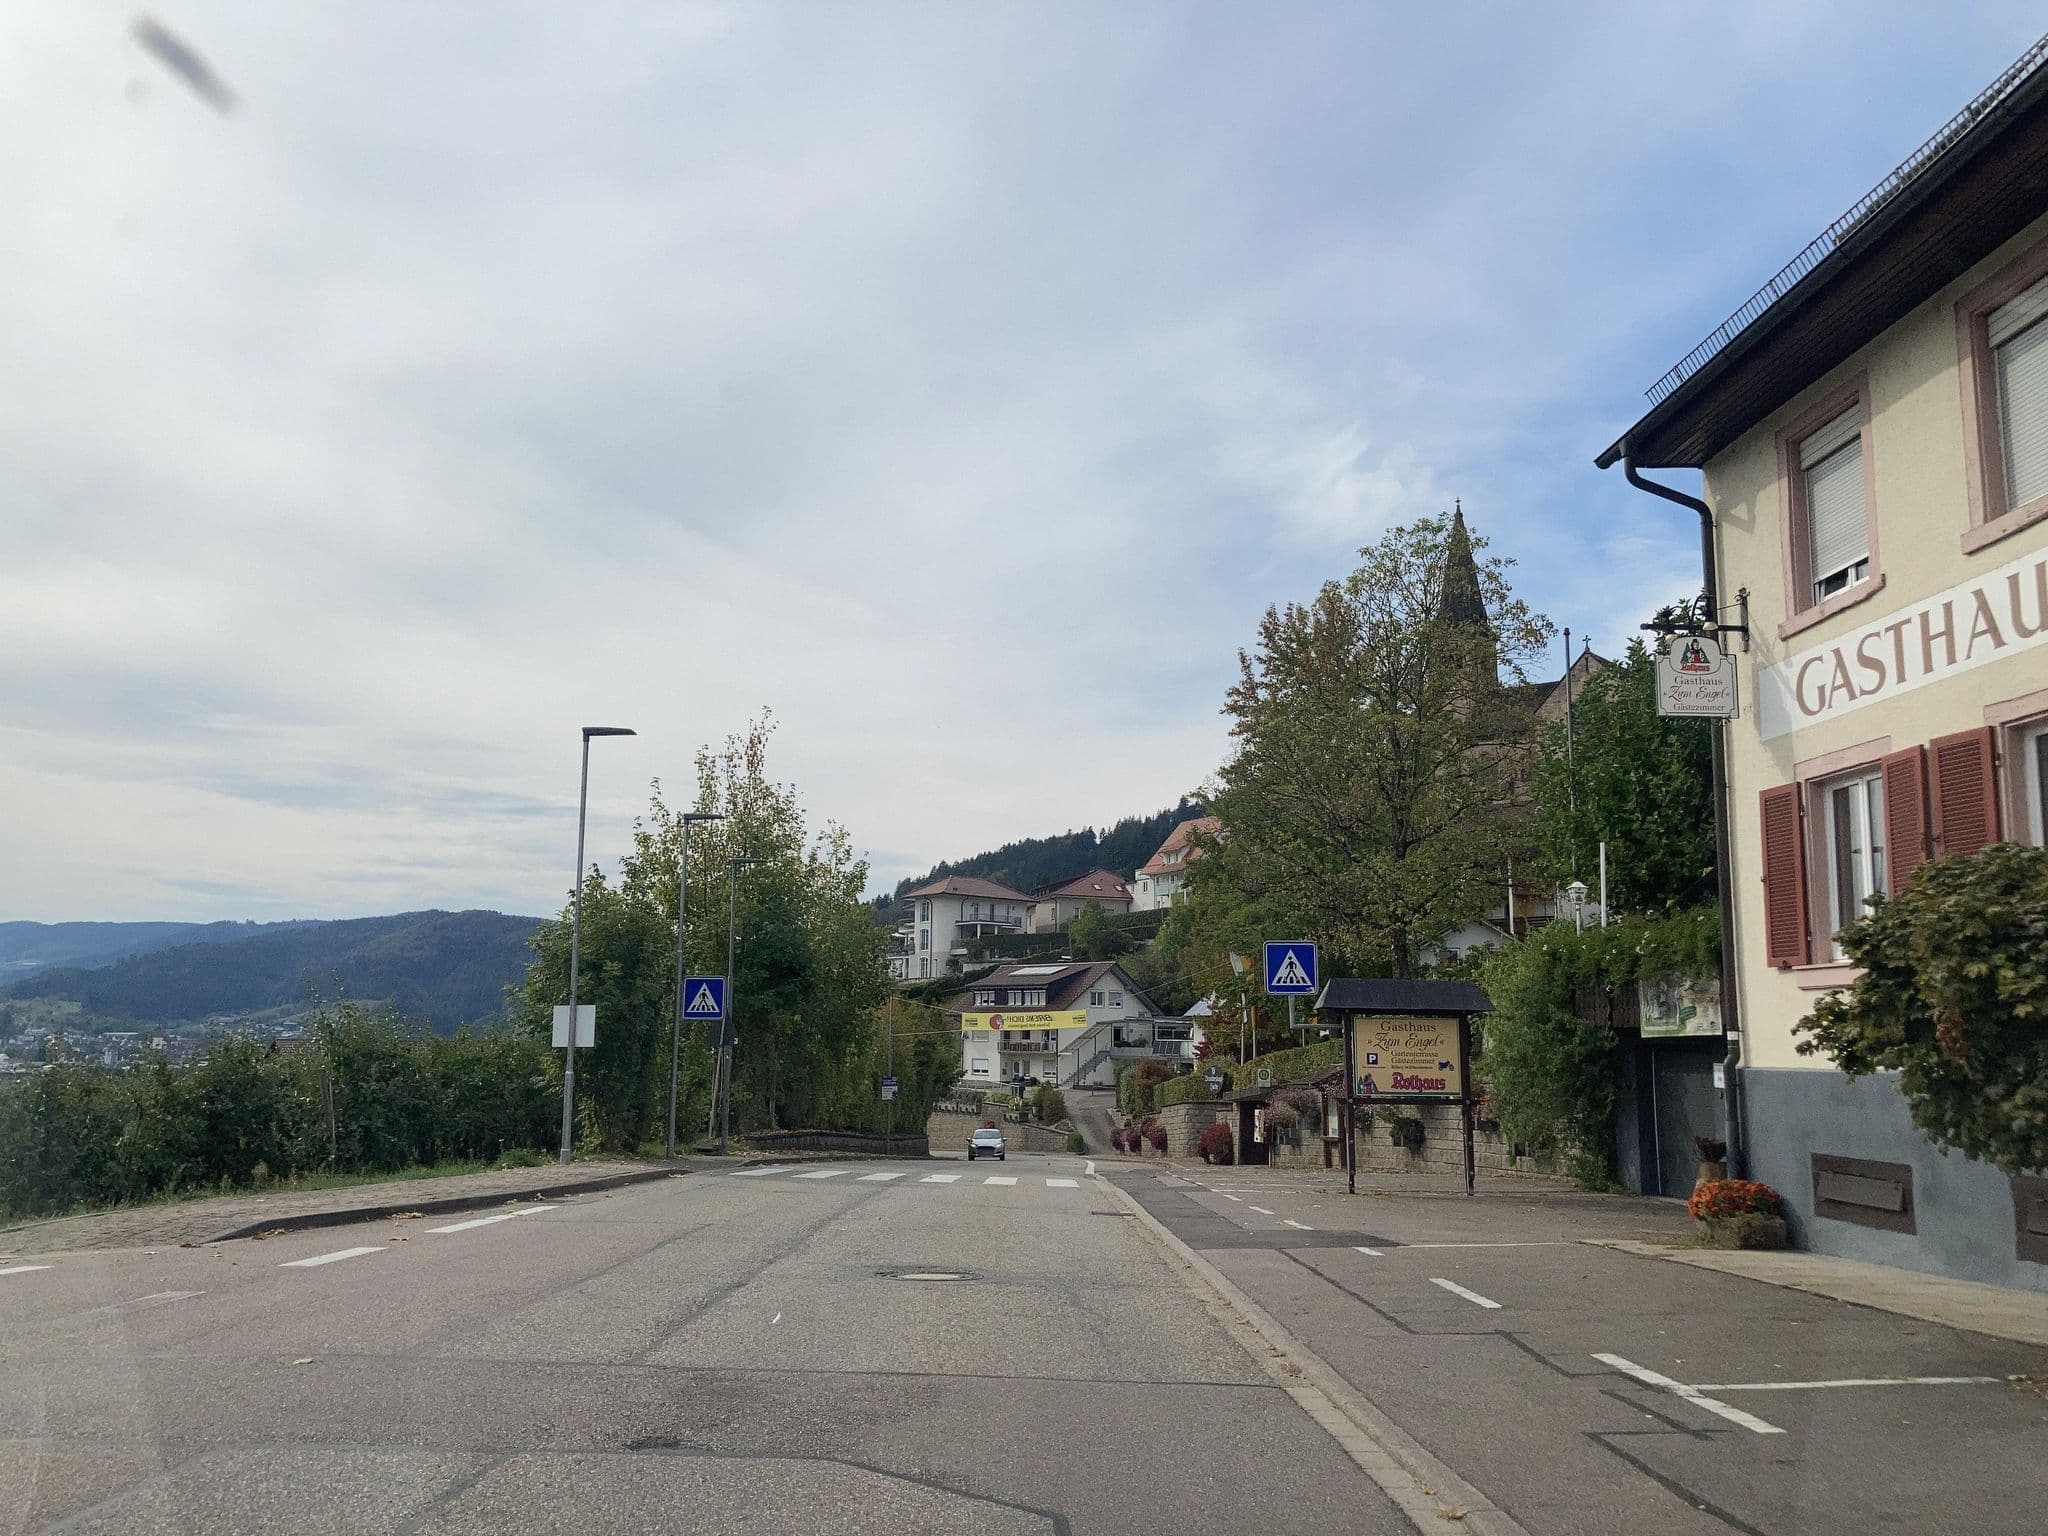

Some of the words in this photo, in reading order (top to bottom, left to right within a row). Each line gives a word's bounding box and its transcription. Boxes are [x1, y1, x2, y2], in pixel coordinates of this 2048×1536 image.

[1795, 559, 2048, 717] GASTHAU
[1674, 676, 1723, 686] Gasthaus
[1380, 1021, 1437, 1032] Gasthaus
[1391, 1072, 1446, 1093] Rothaus
